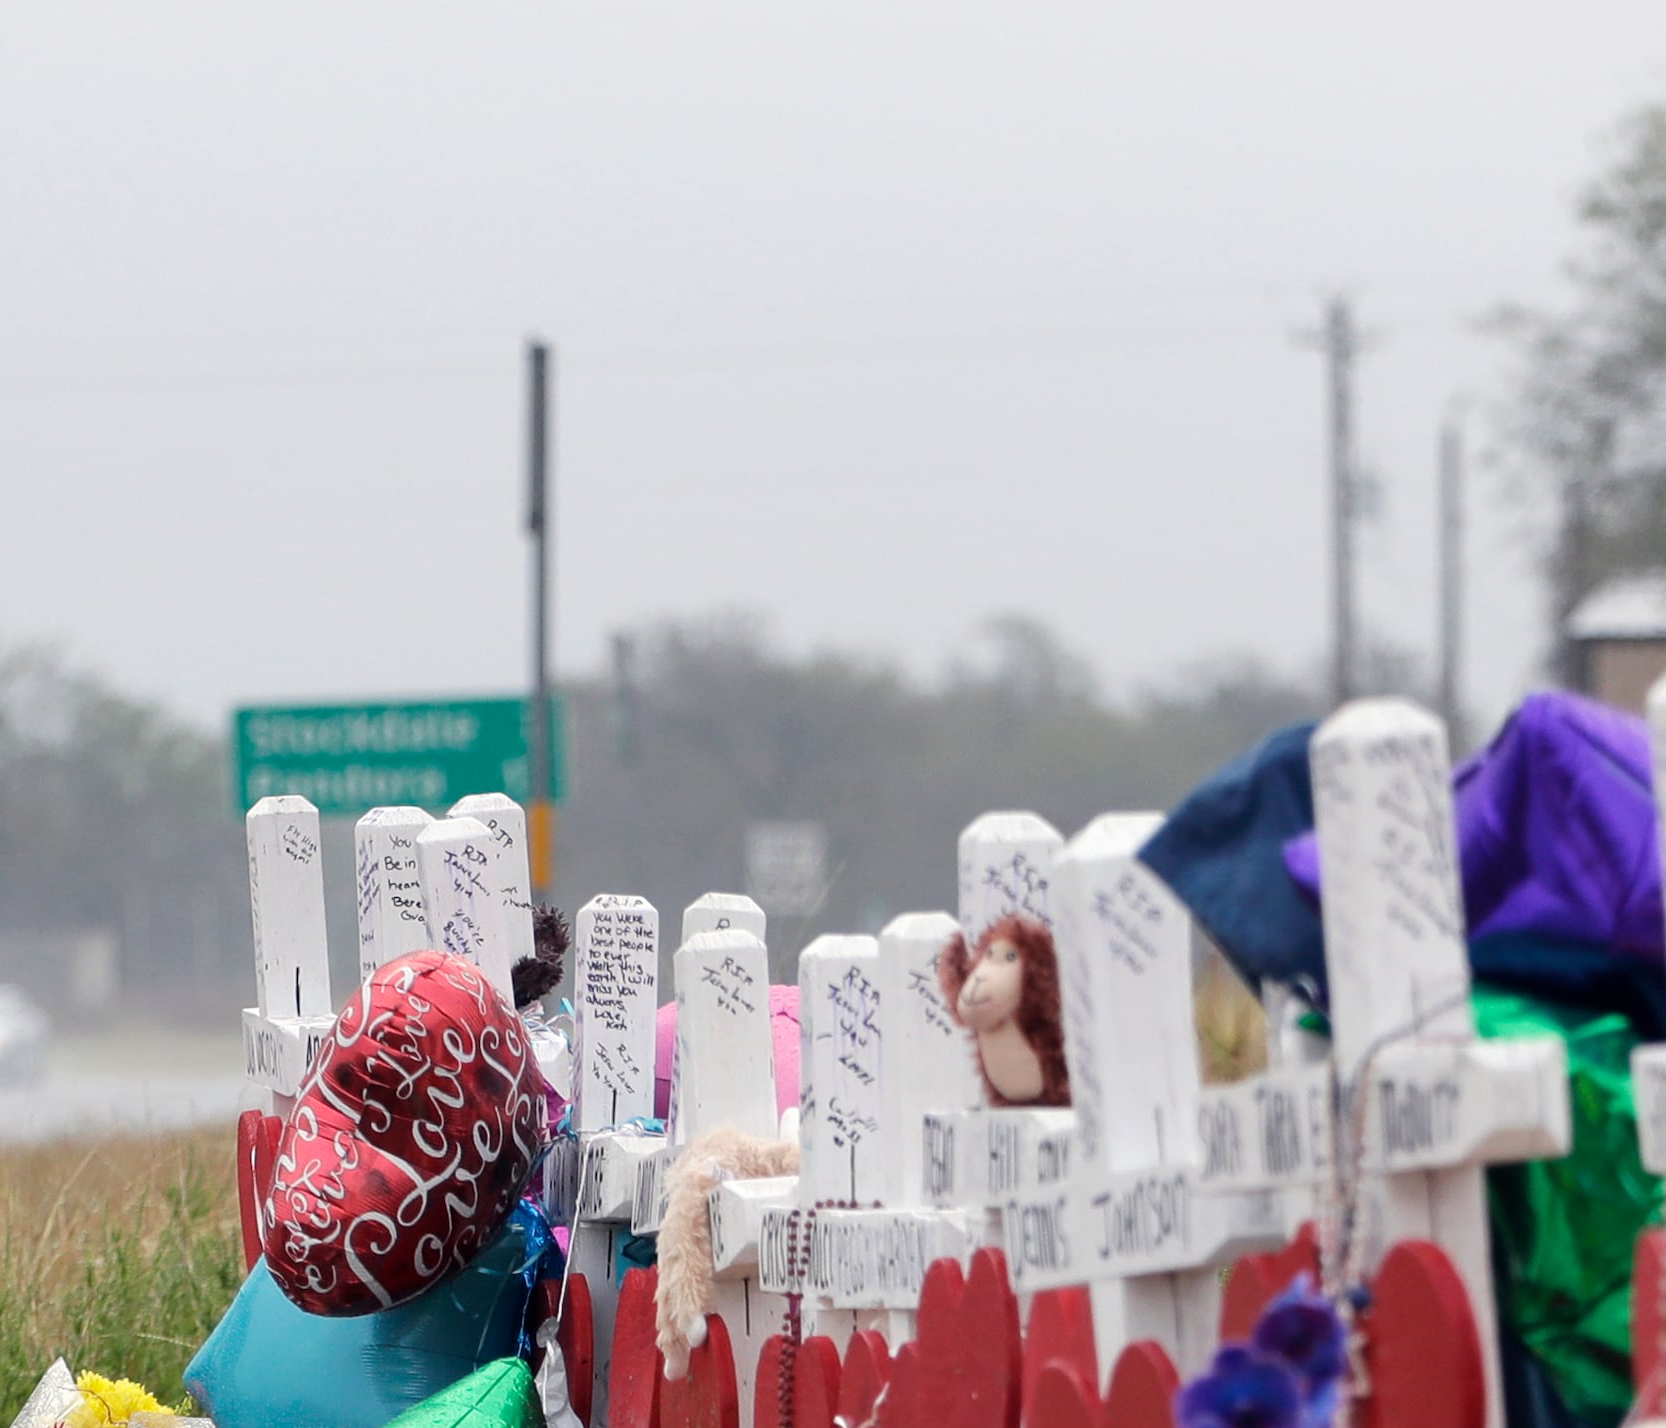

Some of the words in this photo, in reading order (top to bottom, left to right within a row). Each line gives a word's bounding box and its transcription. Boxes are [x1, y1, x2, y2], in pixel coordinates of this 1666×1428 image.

[616, 926, 631, 936] of
[344, 1106, 503, 1310] Love
[353, 1017, 478, 1227] Love
